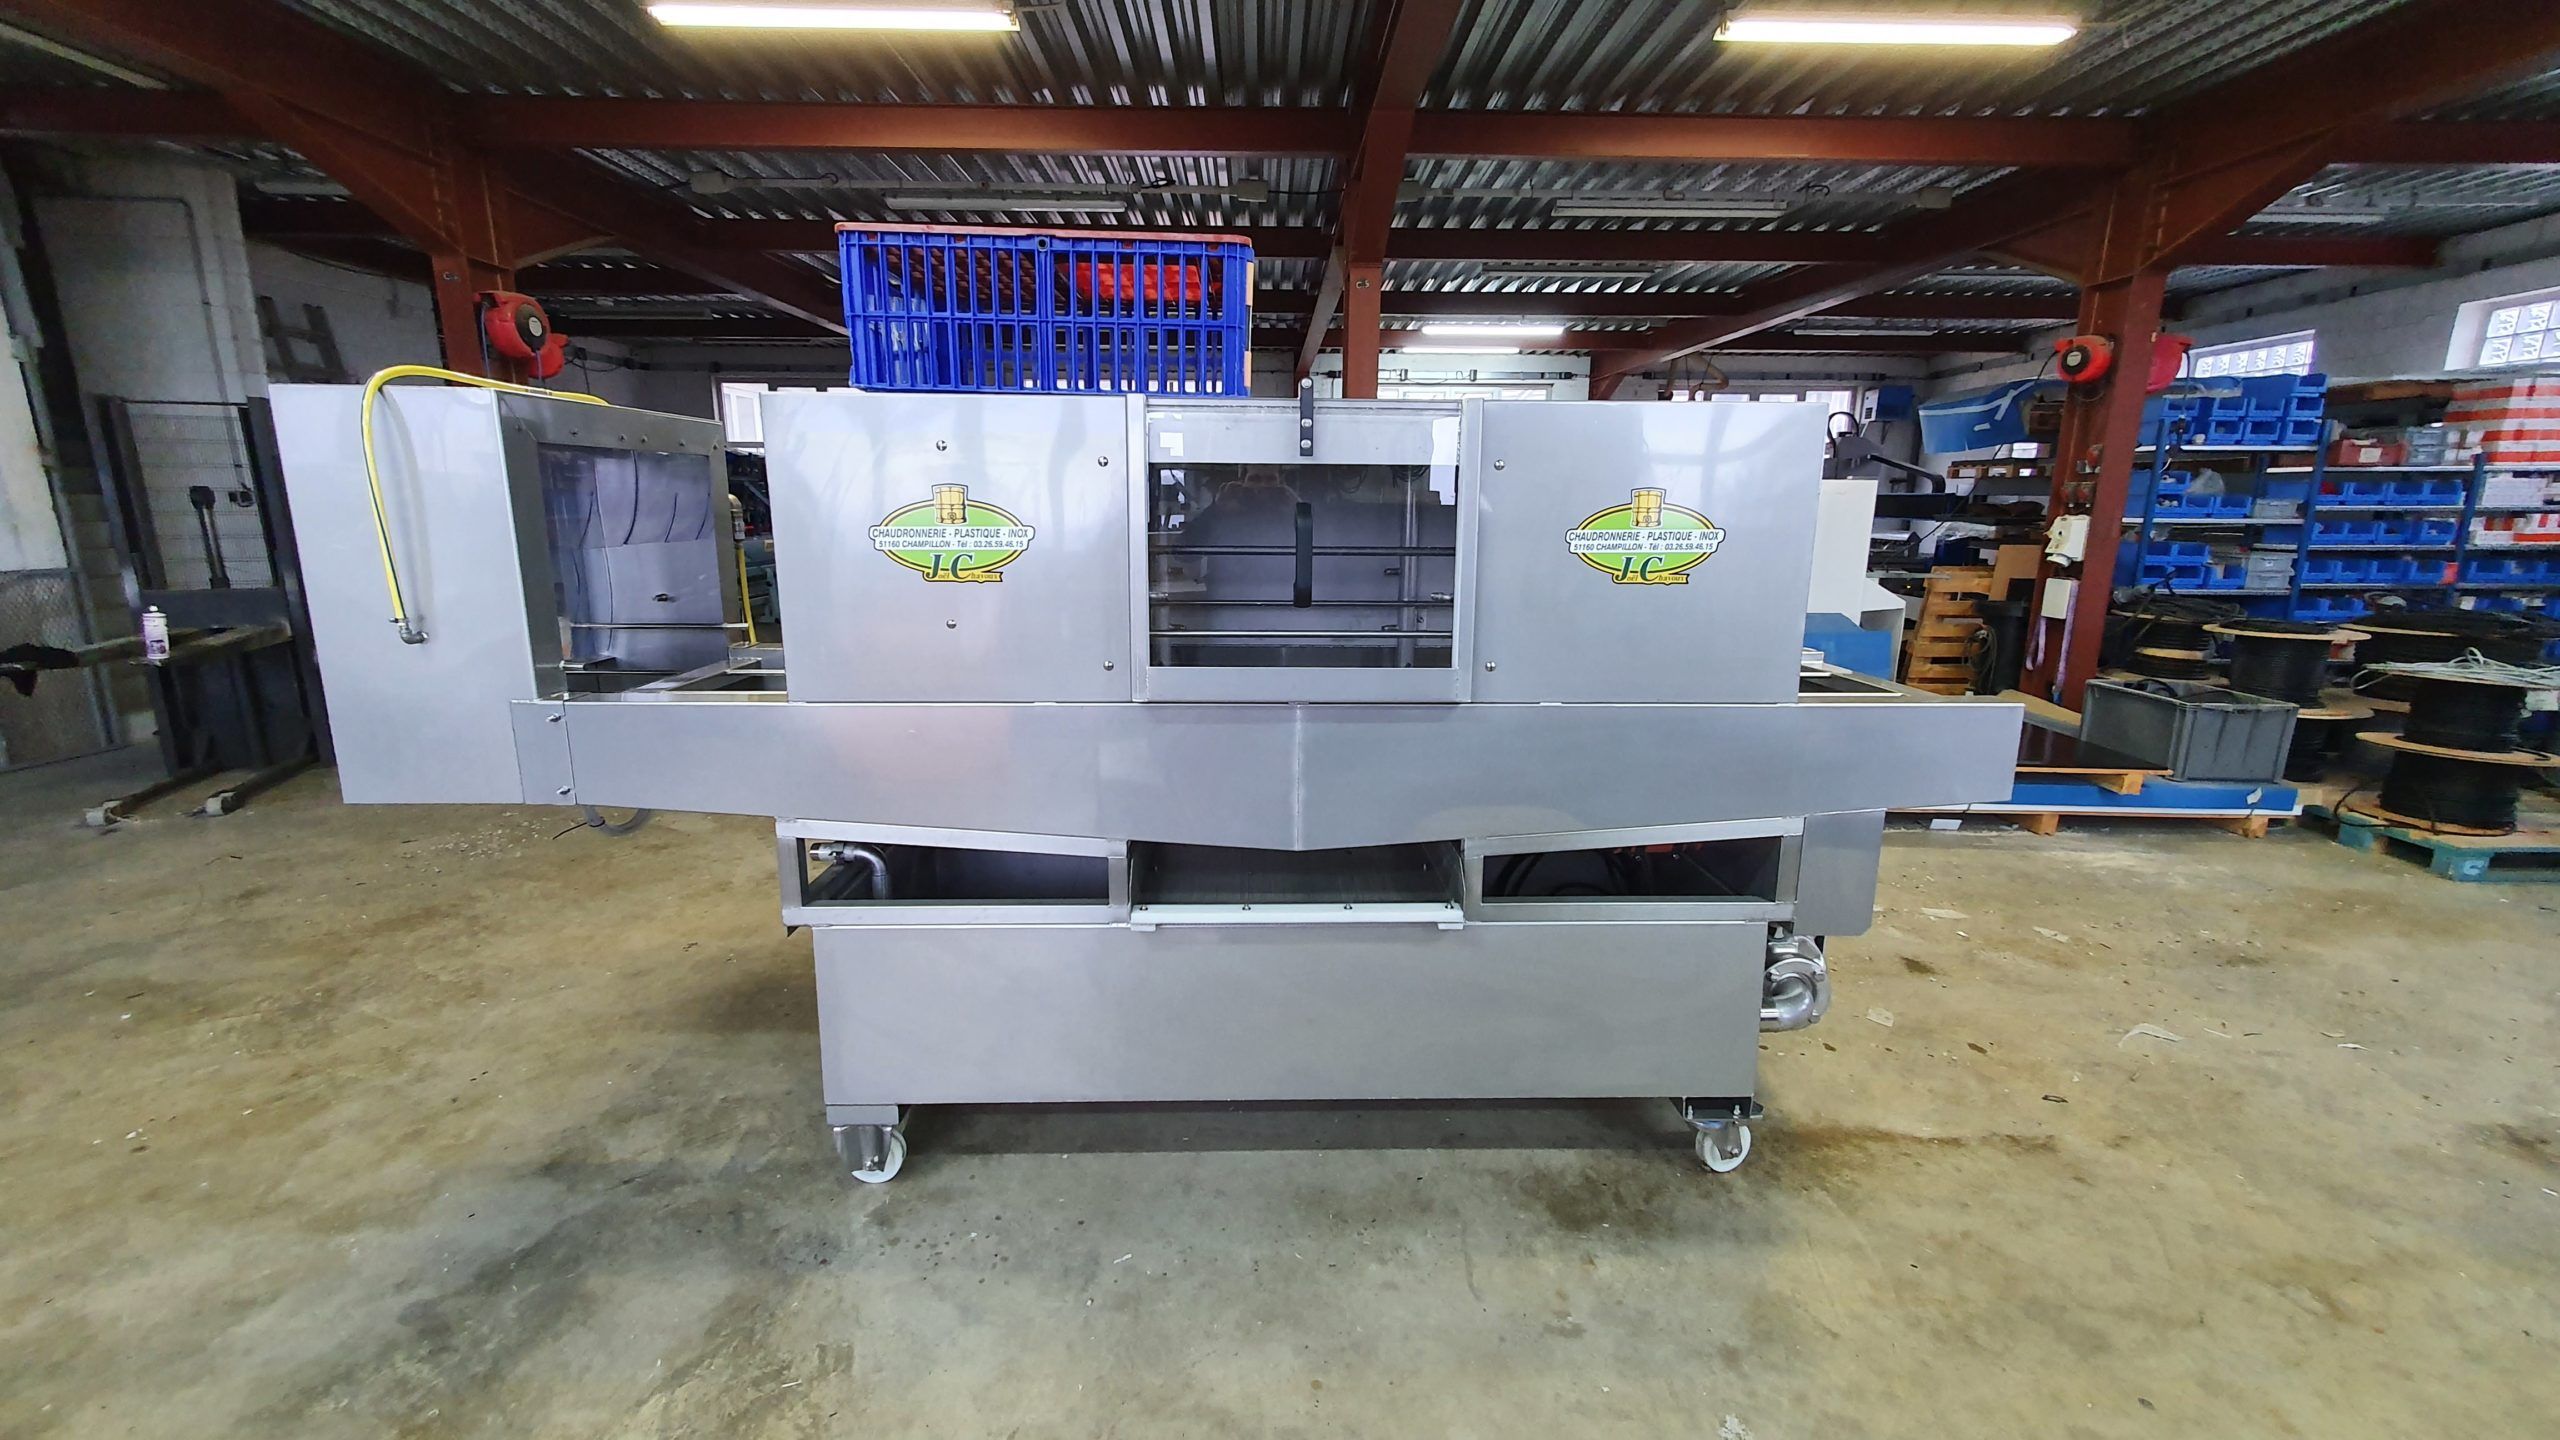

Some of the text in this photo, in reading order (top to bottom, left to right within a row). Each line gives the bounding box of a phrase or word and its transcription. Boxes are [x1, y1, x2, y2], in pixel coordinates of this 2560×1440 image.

[872, 528, 947, 538] CHAUDRONNERIE
[954, 528, 1001, 538] PLASTIQUE
[1008, 528, 1028, 538] INOX
[1568, 531, 1640, 541] CHAUDRONNERIE
[1647, 531, 1693, 541] PLASTIQUE
[1699, 531, 1719, 541] INOX
[878, 540, 900, 548] 51160
[902, 540, 951, 548] CHAMPILLON
[1573, 543, 1595, 551] 51160
[1596, 543, 1643, 551] CHAMPILLON
